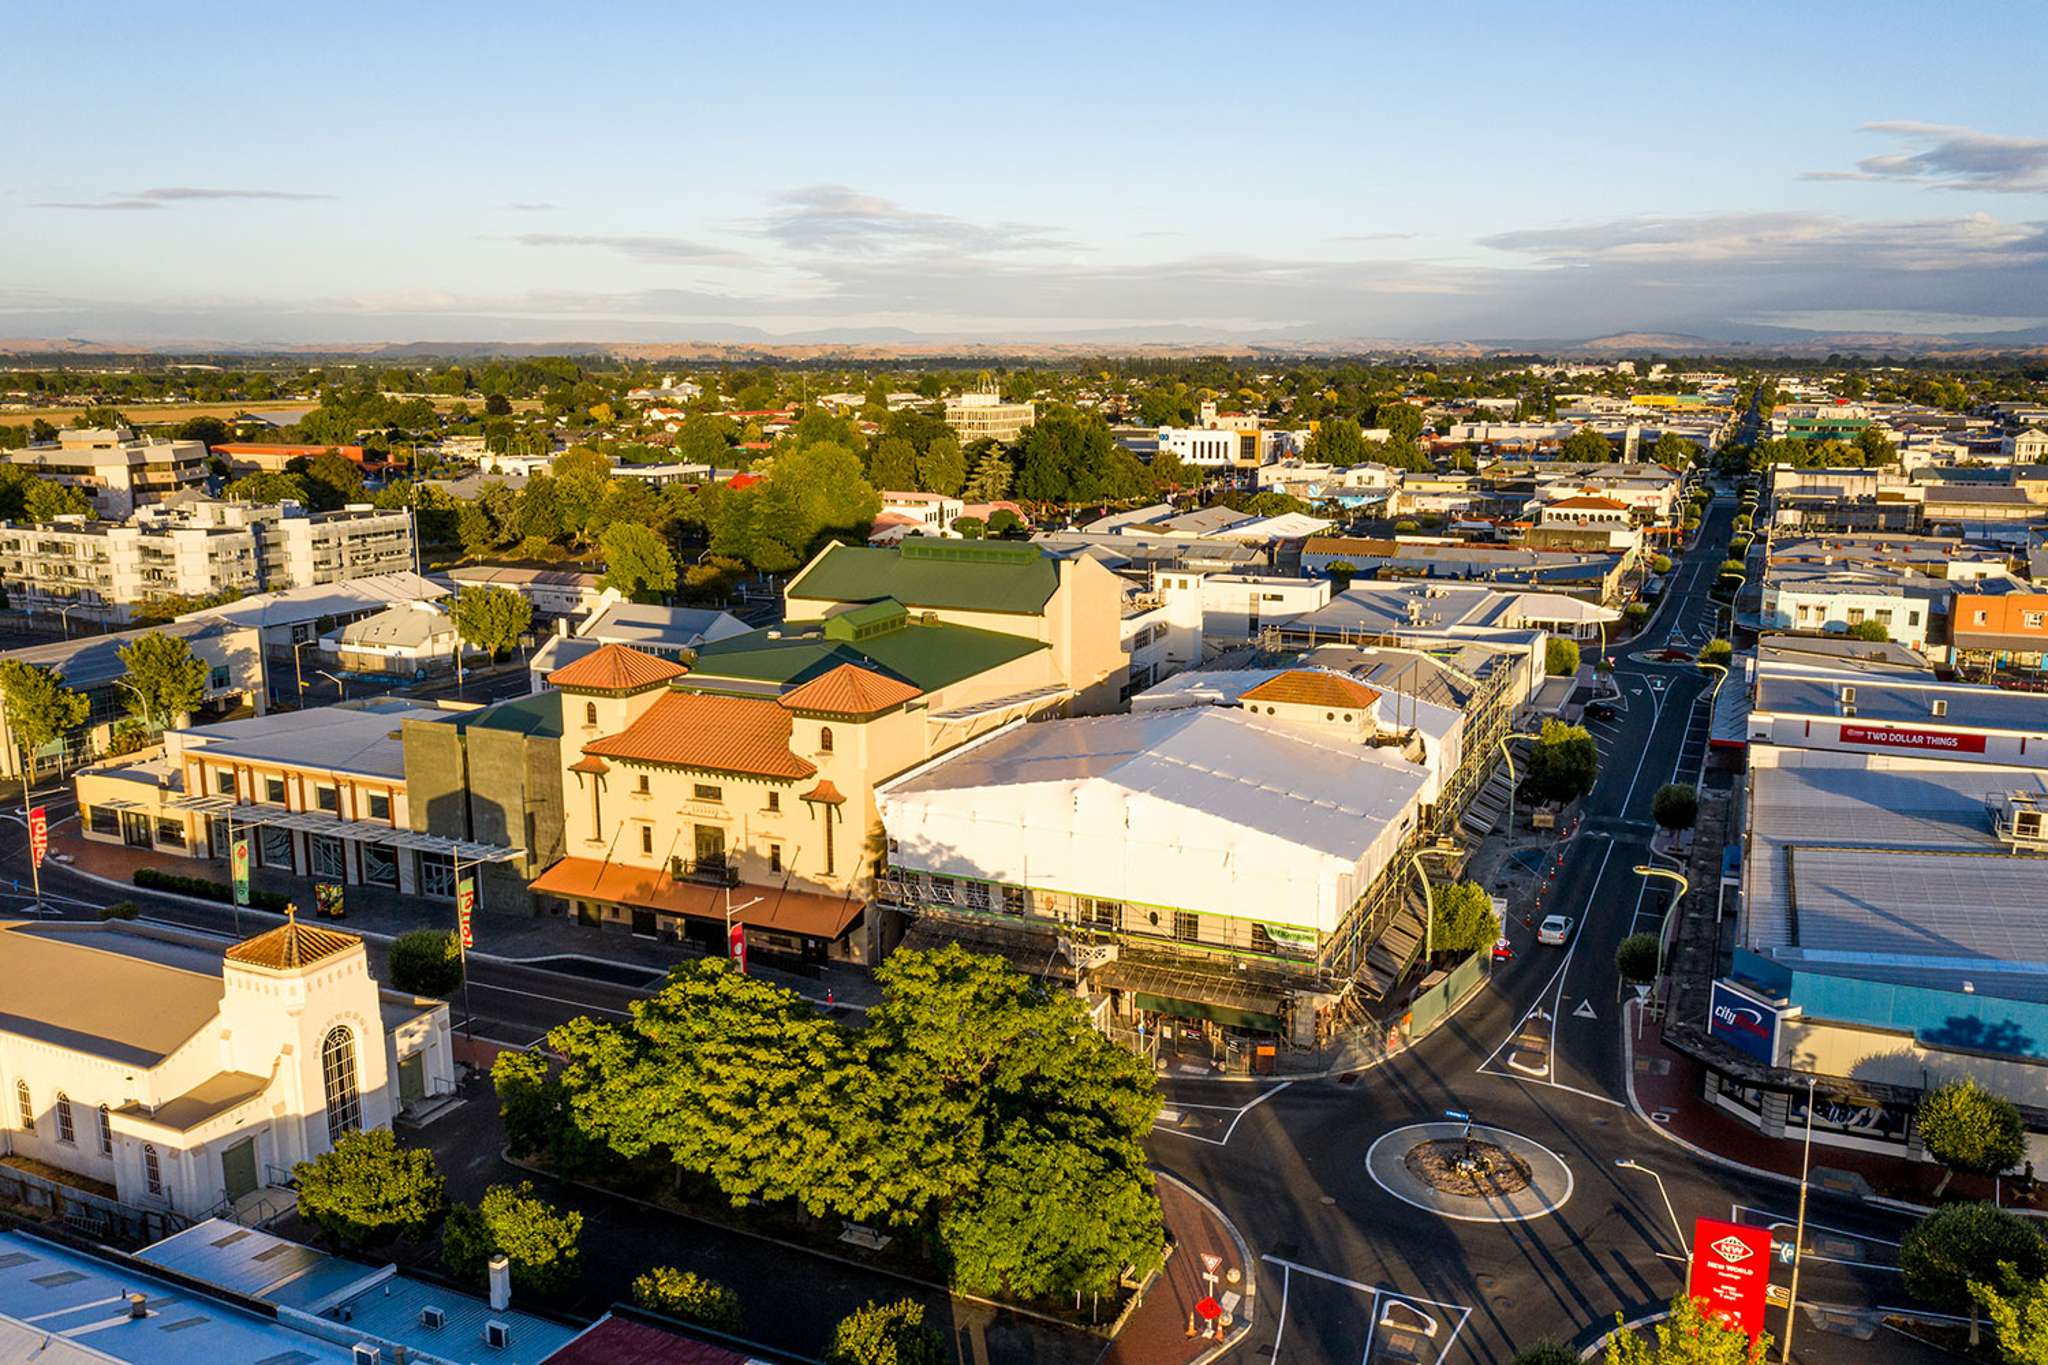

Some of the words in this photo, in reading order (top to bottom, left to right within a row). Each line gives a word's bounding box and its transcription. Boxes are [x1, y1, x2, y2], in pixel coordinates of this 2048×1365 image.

[1866, 731, 1888, 741] TWO
[1888, 734, 1923, 745] DOLLAR
[1925, 736, 1958, 747] THINGS
[1720, 1243, 1745, 1255] NW
[1785, 1248, 1794, 1259] P
[1707, 1261, 1725, 1270] NEW
[1726, 1264, 1754, 1276] WORLD
